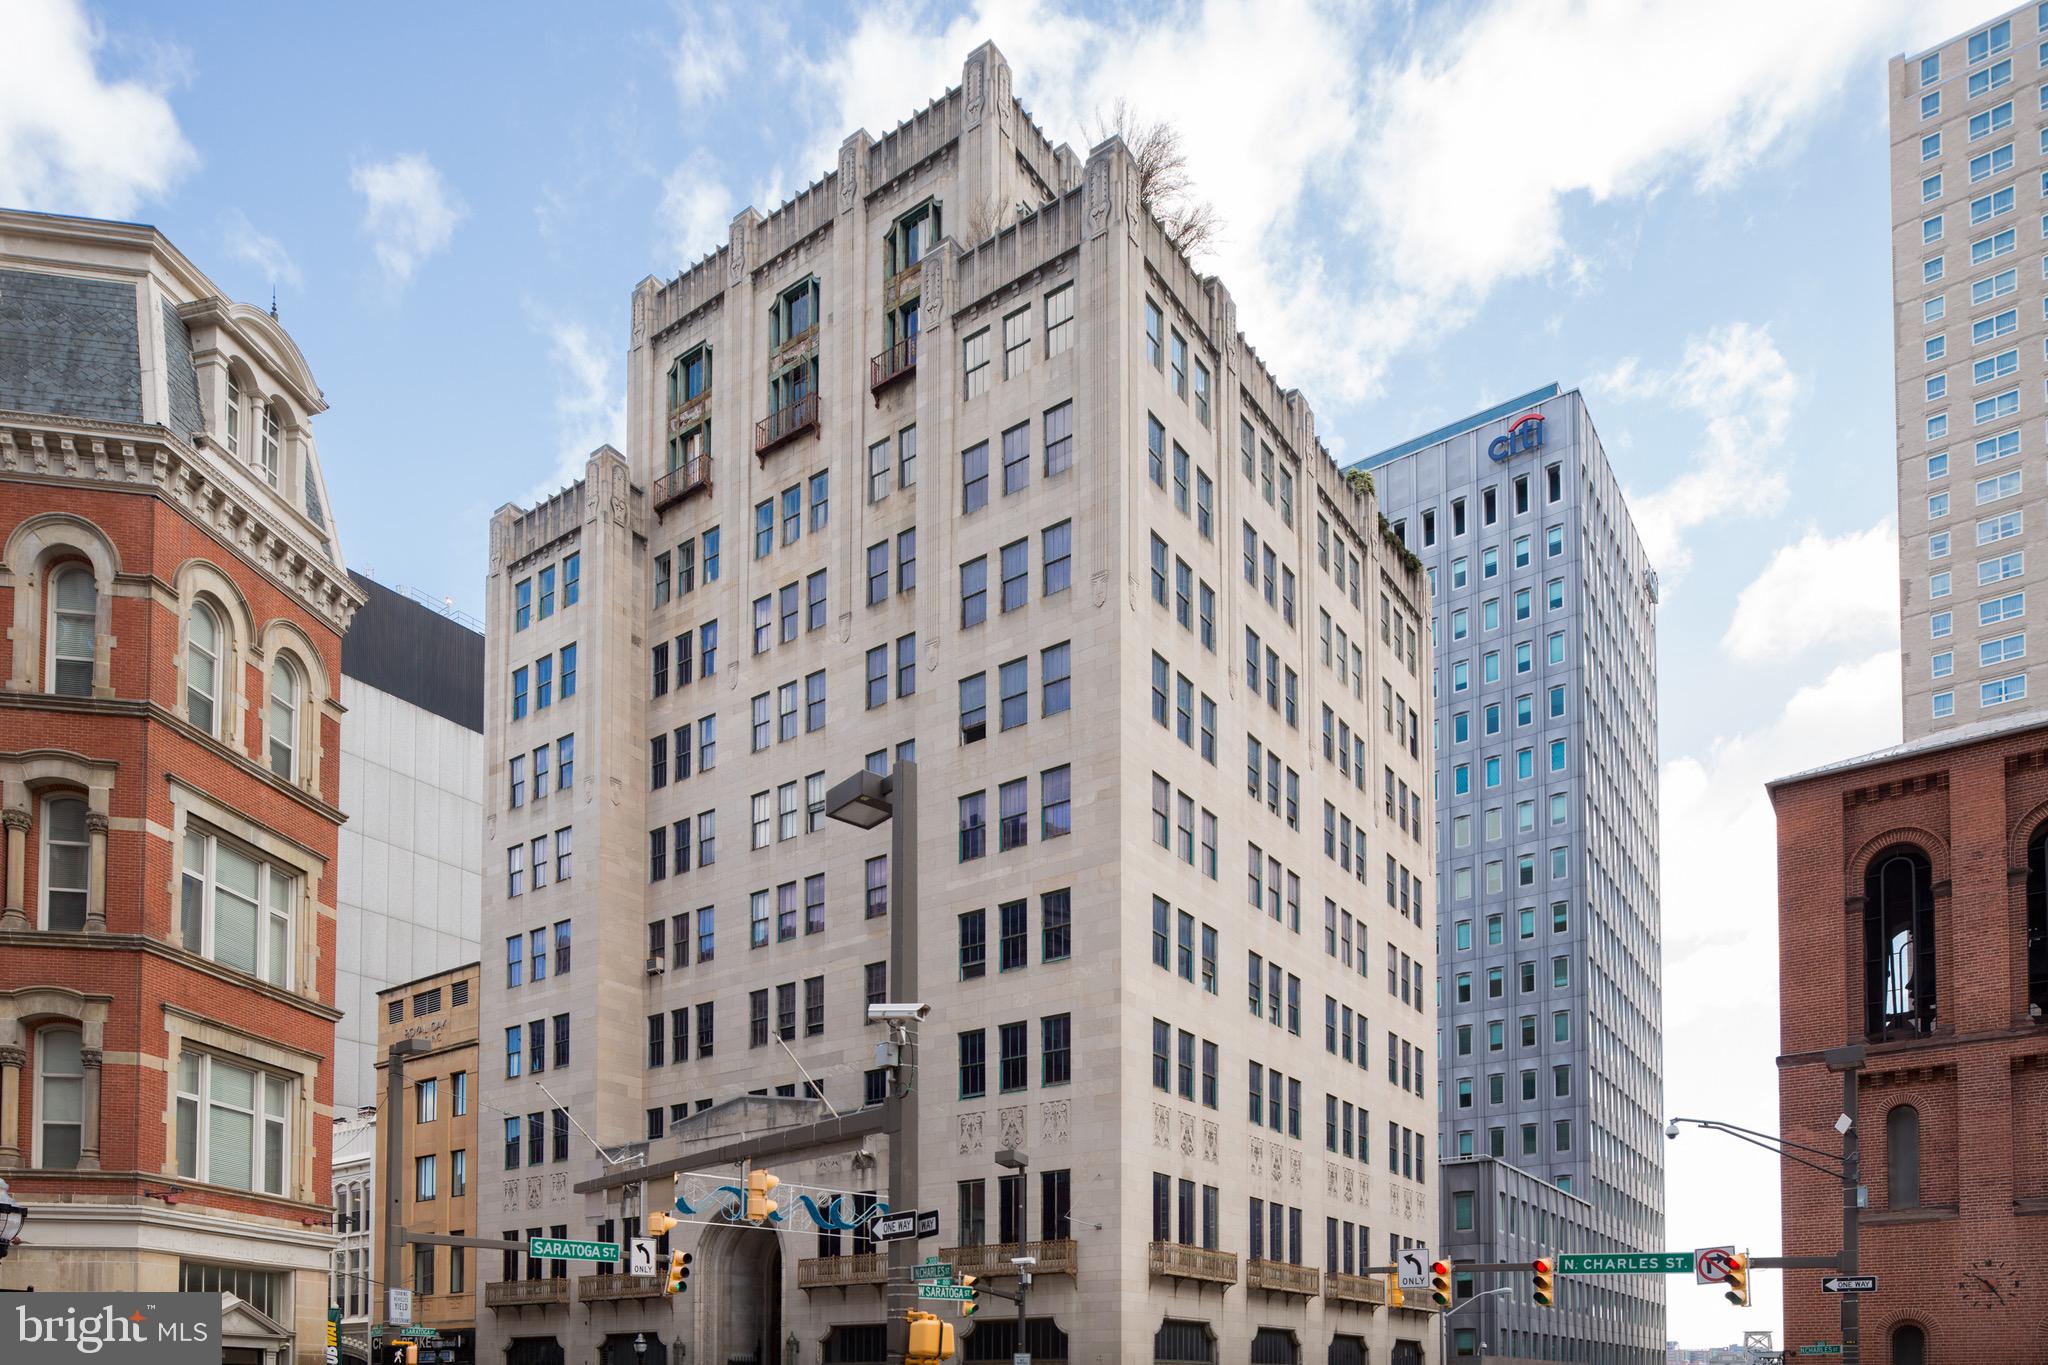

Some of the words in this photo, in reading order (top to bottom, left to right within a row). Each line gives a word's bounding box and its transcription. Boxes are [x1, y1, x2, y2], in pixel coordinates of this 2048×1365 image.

[1488, 417, 1543, 462] citi
[883, 1221, 896, 1233] ONE
[898, 1219, 911, 1231] WAY
[921, 1219, 935, 1231] WAY
[534, 1241, 601, 1257] SARATOGA
[602, 1246, 617, 1258] ST.
[634, 1265, 653, 1273] ONLY
[1564, 1259, 1578, 1270] N.
[1583, 1257, 1659, 1269] CHARLES
[1665, 1257, 1688, 1269] ST.
[920, 1266, 945, 1278] CHARLES
[1402, 1277, 1425, 1285] ONLY
[925, 1286, 964, 1298] SARATOGA
[394, 1303, 409, 1311] YIELD
